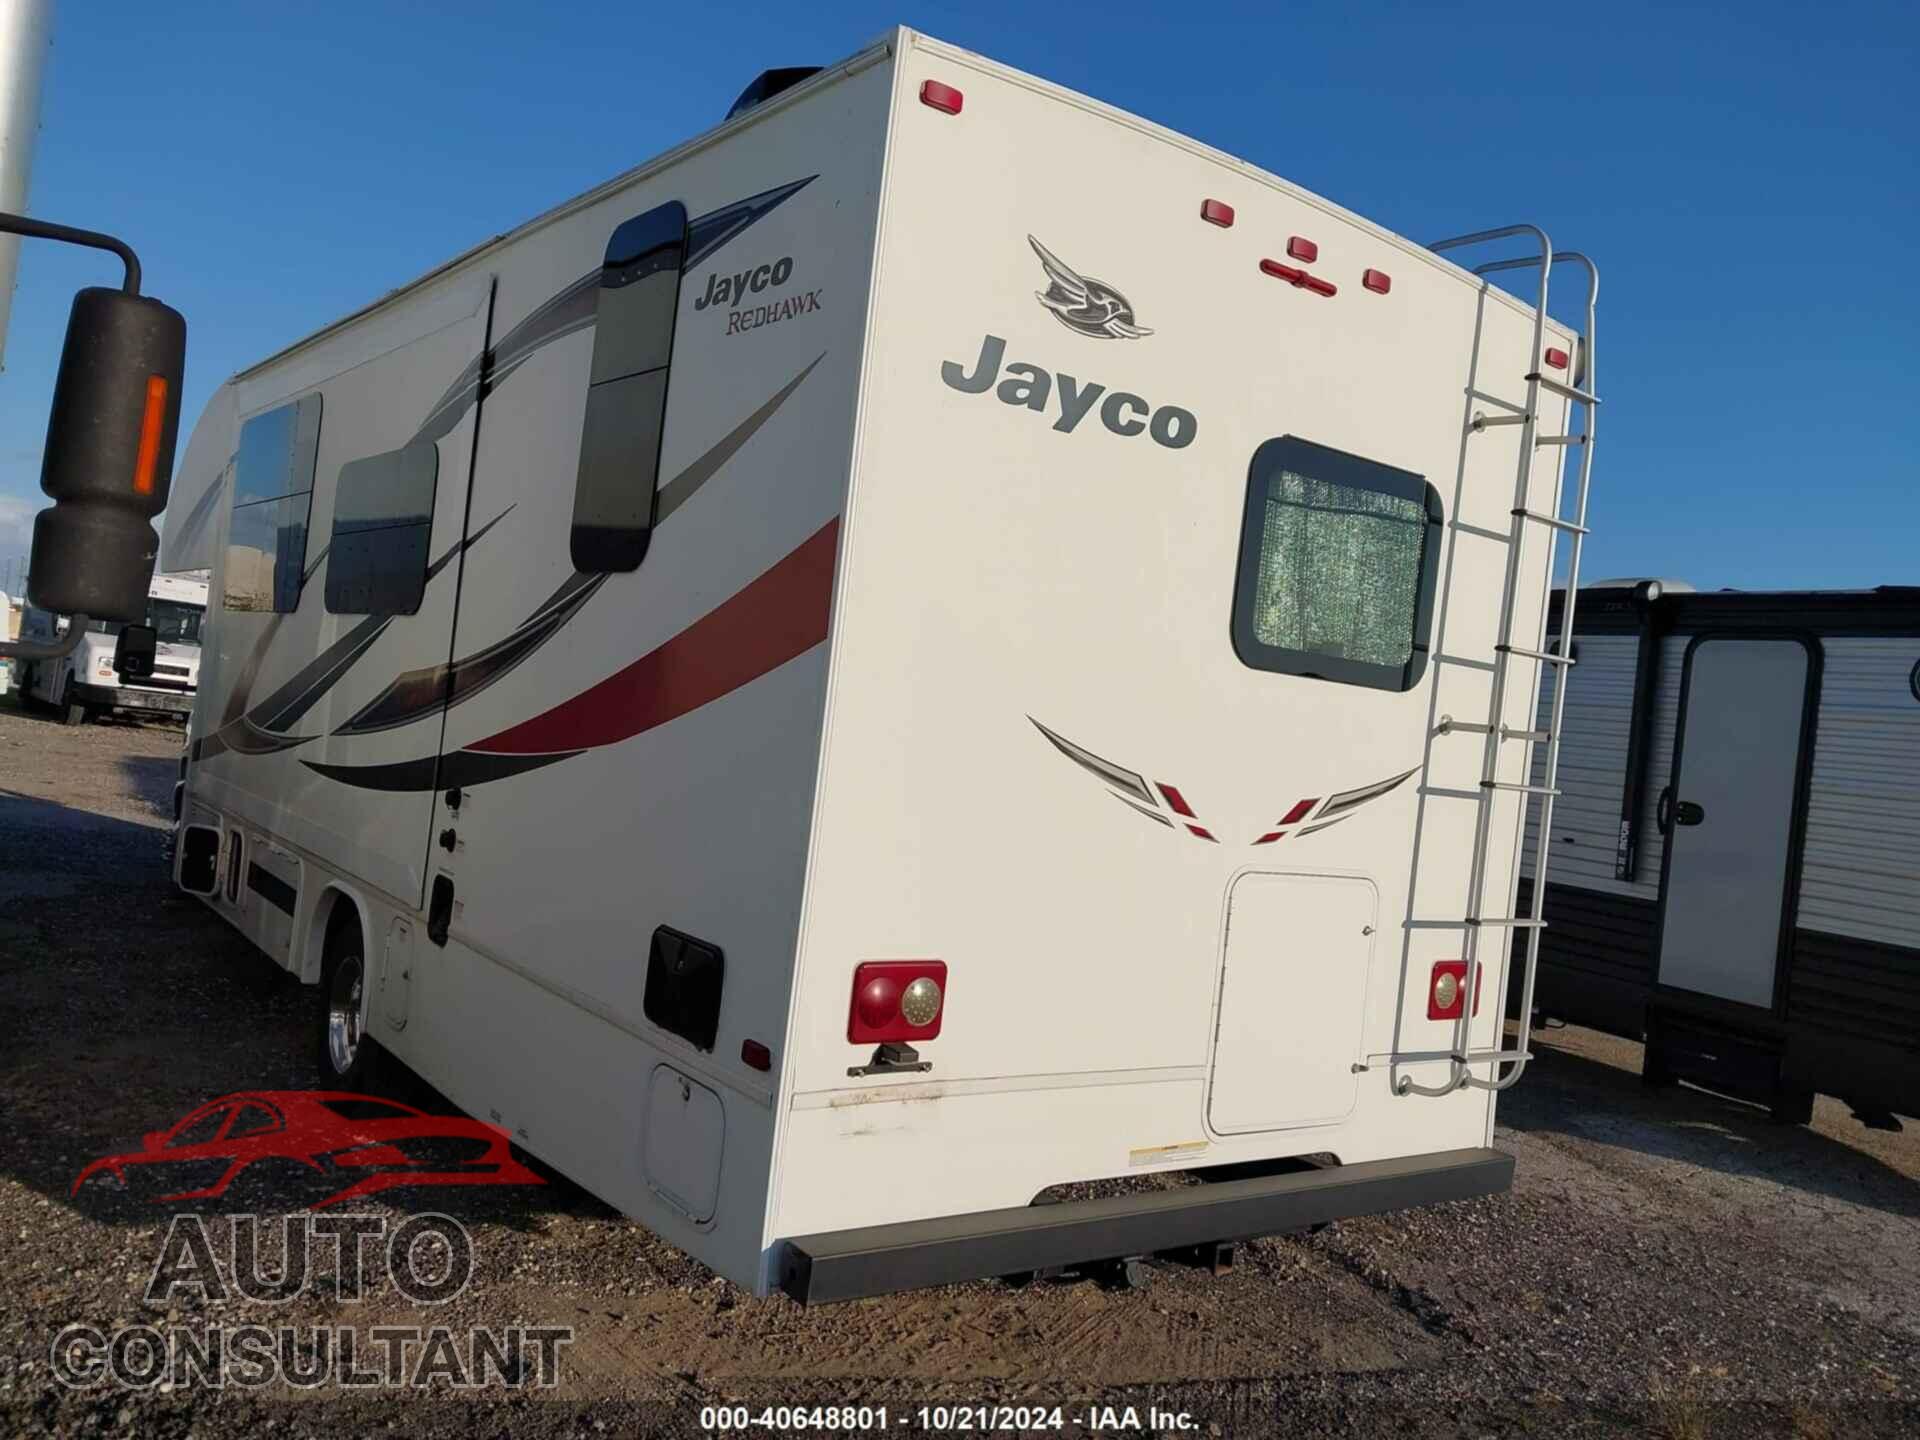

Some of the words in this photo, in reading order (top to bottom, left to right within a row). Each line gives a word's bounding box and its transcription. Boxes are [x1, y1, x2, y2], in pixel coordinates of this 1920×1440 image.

[695, 256, 793, 312] Jayco
[727, 289, 823, 335] REDHAWK
[941, 334, 1197, 449] Jayco
